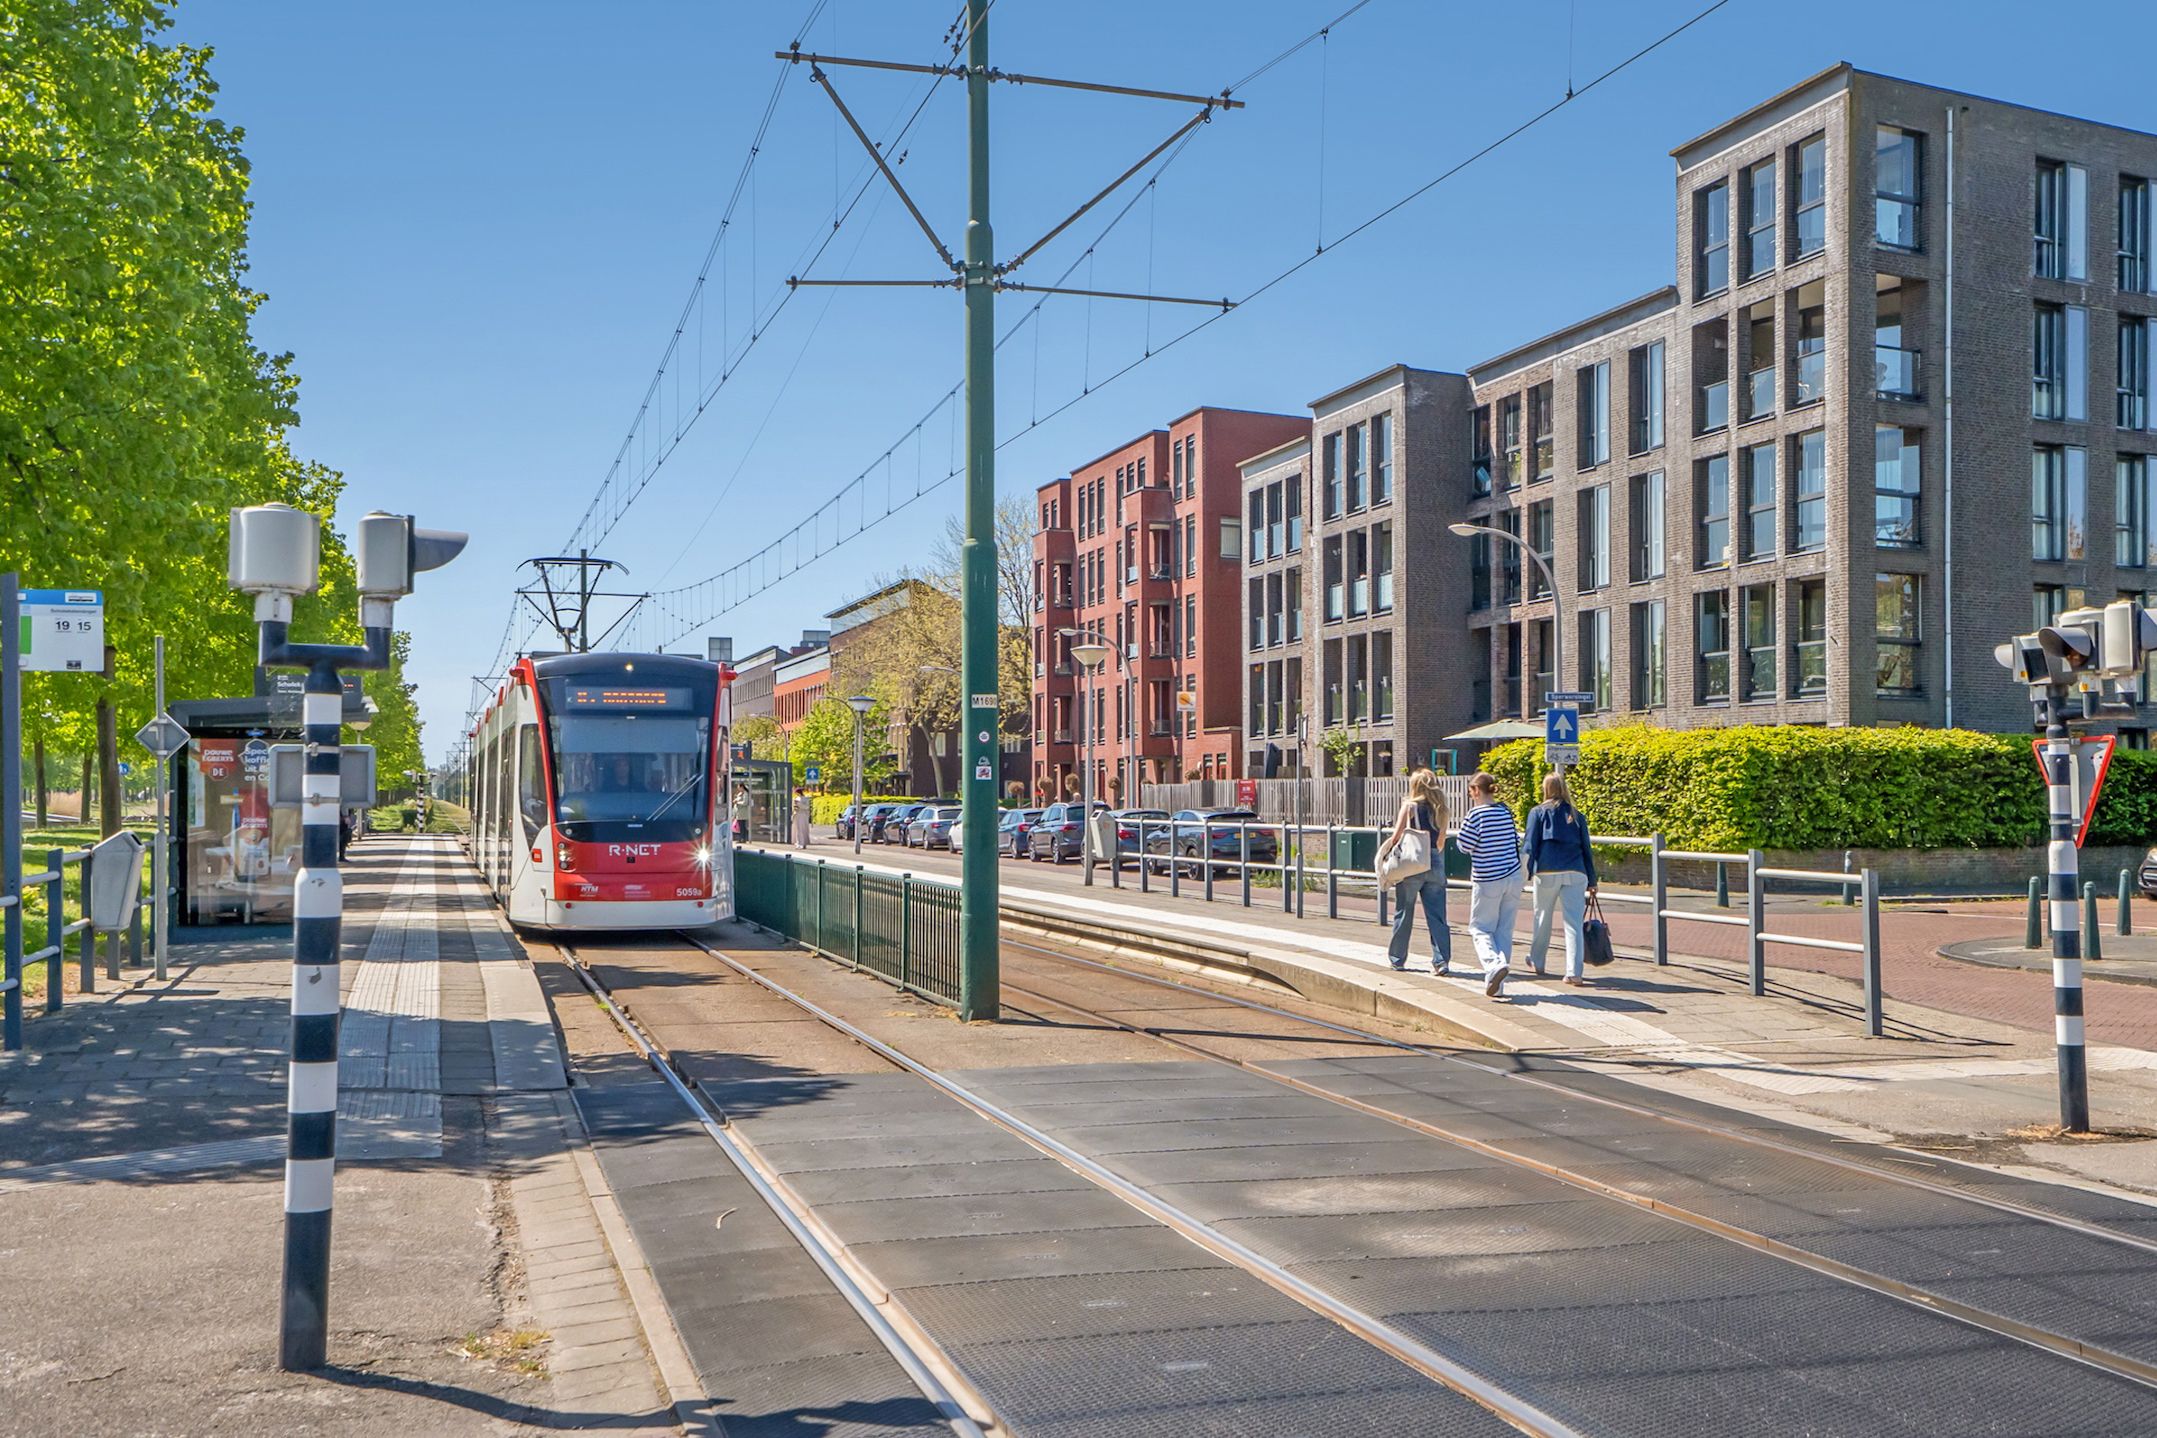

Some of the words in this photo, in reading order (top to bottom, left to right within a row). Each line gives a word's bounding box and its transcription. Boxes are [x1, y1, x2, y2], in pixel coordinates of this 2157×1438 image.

[55, 620, 70, 631] 19
[77, 621, 92, 631] 15
[245, 748, 269, 756] Spec
[212, 767, 224, 777] DE
[676, 887, 703, 897] 5059a
